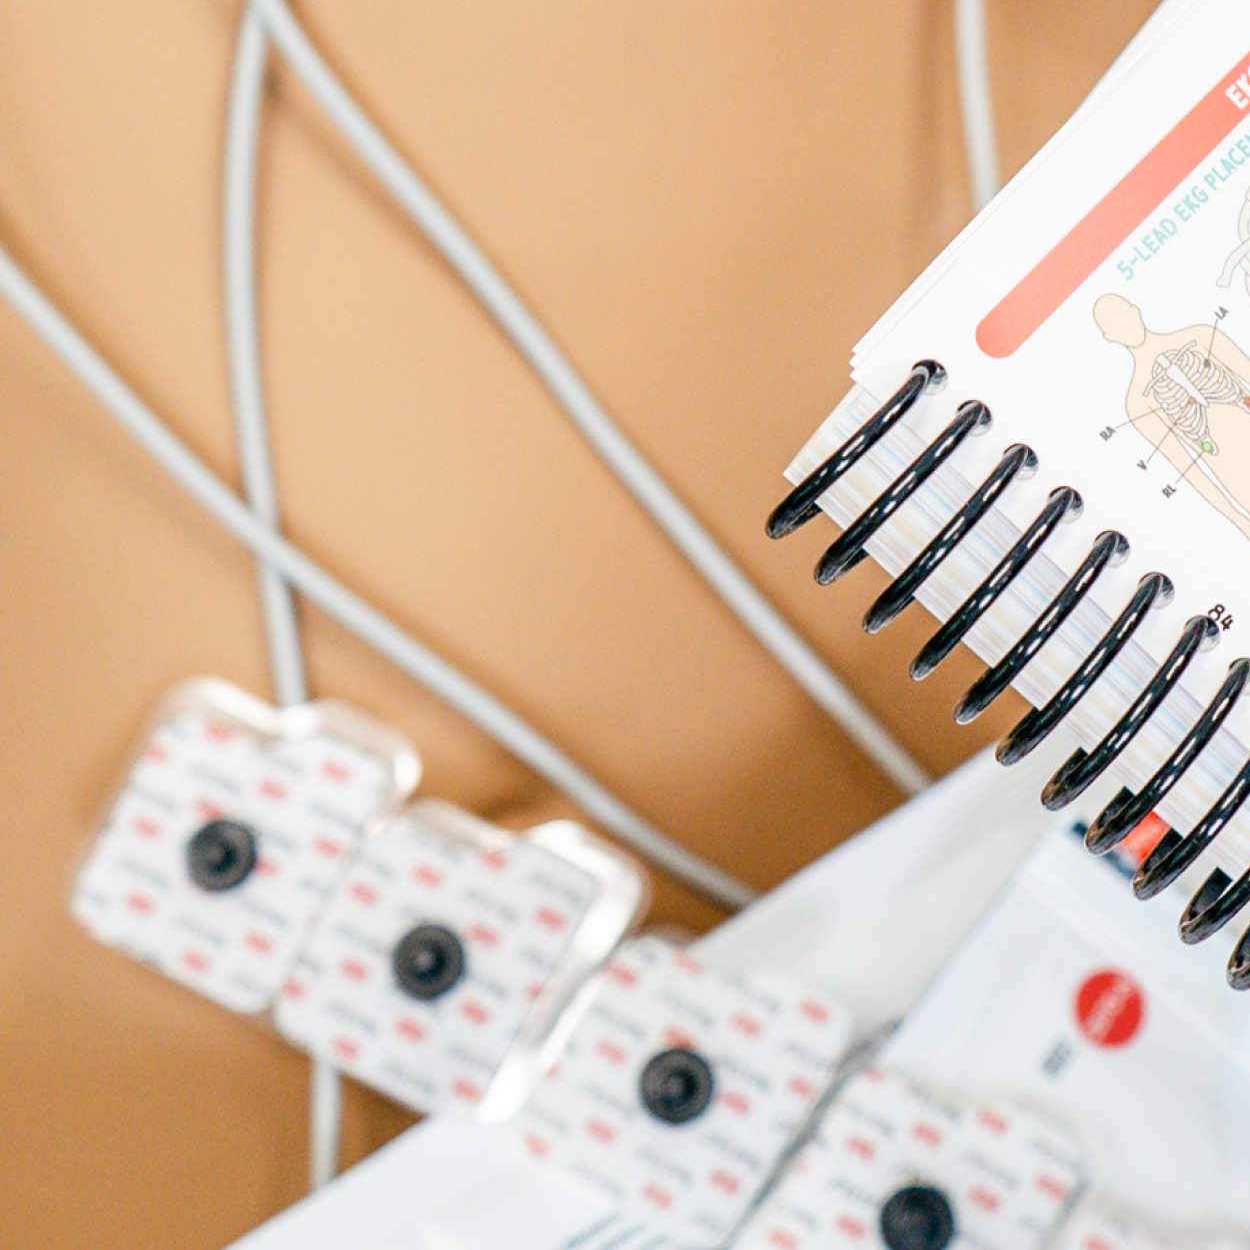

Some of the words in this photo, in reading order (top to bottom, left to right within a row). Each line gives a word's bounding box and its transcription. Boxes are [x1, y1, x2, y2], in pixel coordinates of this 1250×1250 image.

[1114, 216, 1179, 281] 5-LEAD
[1172, 183, 1210, 223] EKG
[1213, 305, 1229, 320] LA
[1098, 425, 1116, 441] RA
[1136, 459, 1148, 470] V
[1161, 483, 1177, 498] RL
[1207, 603, 1234, 631] 84
